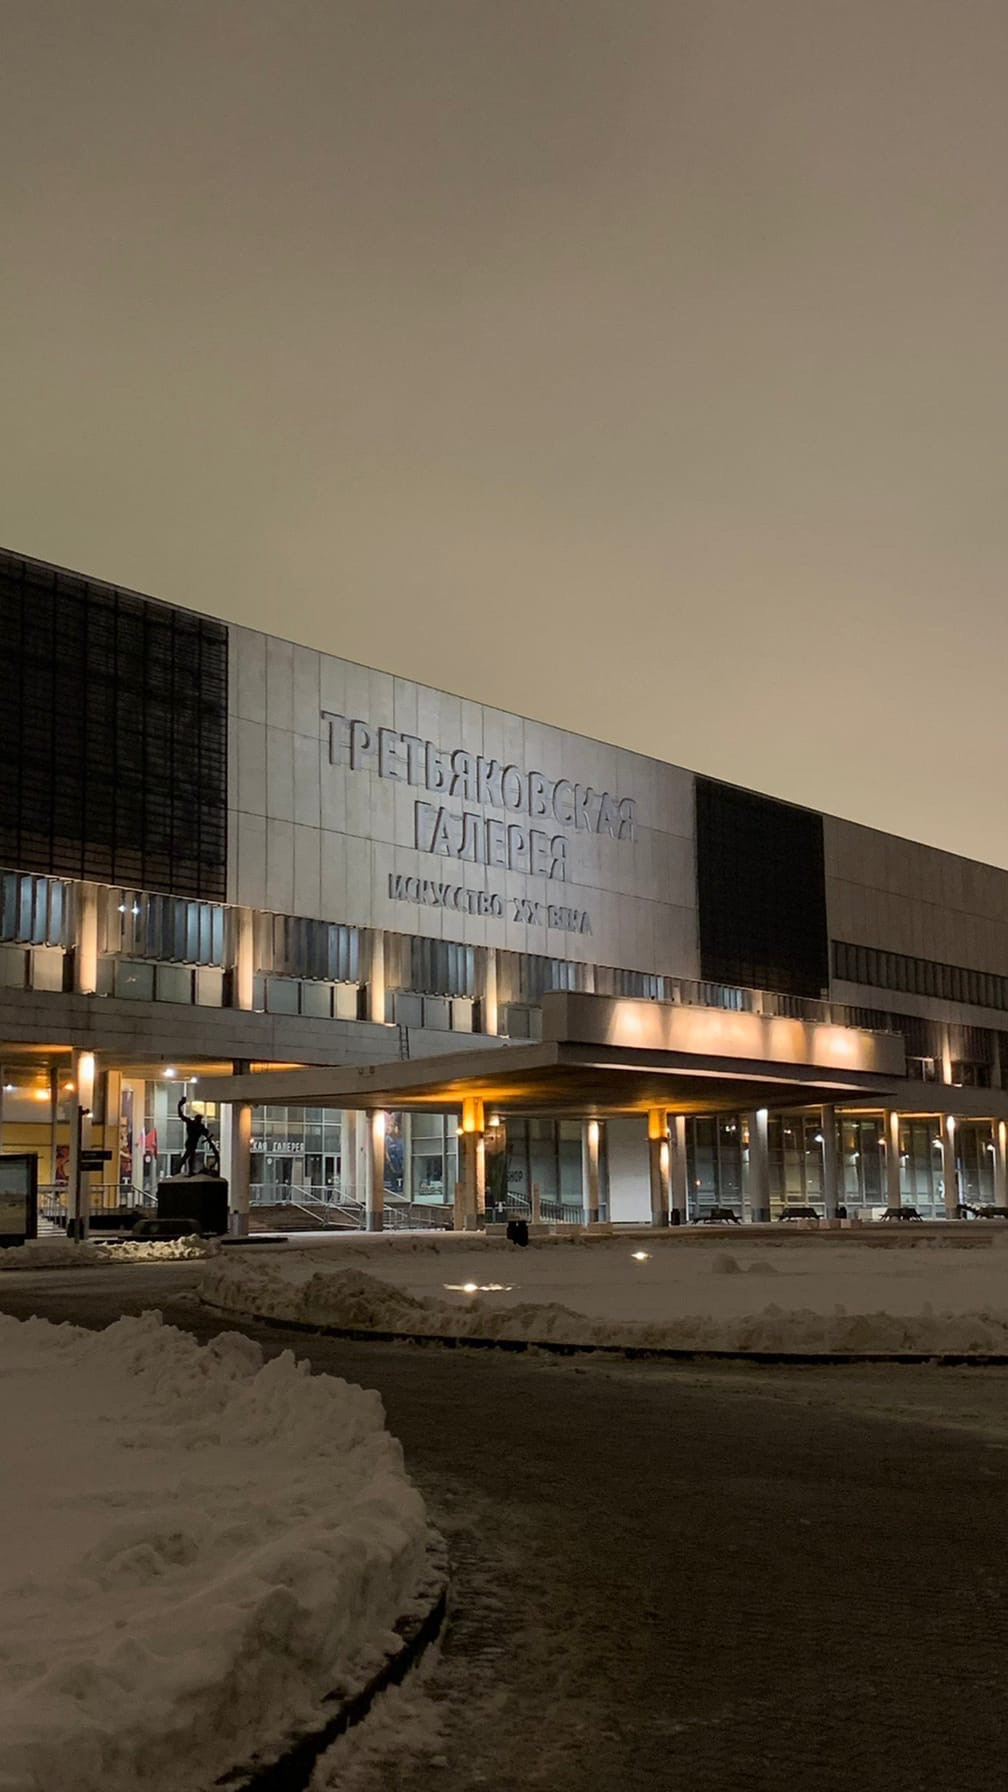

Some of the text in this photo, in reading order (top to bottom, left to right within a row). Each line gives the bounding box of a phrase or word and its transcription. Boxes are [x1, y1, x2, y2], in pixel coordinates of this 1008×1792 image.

[320, 710, 637, 841] ТРЕТЬЯКОВСКАЯ
[414, 800, 569, 882] ГАЛЕРЕЯ
[388, 872, 503, 918] ИСКУССТВО
